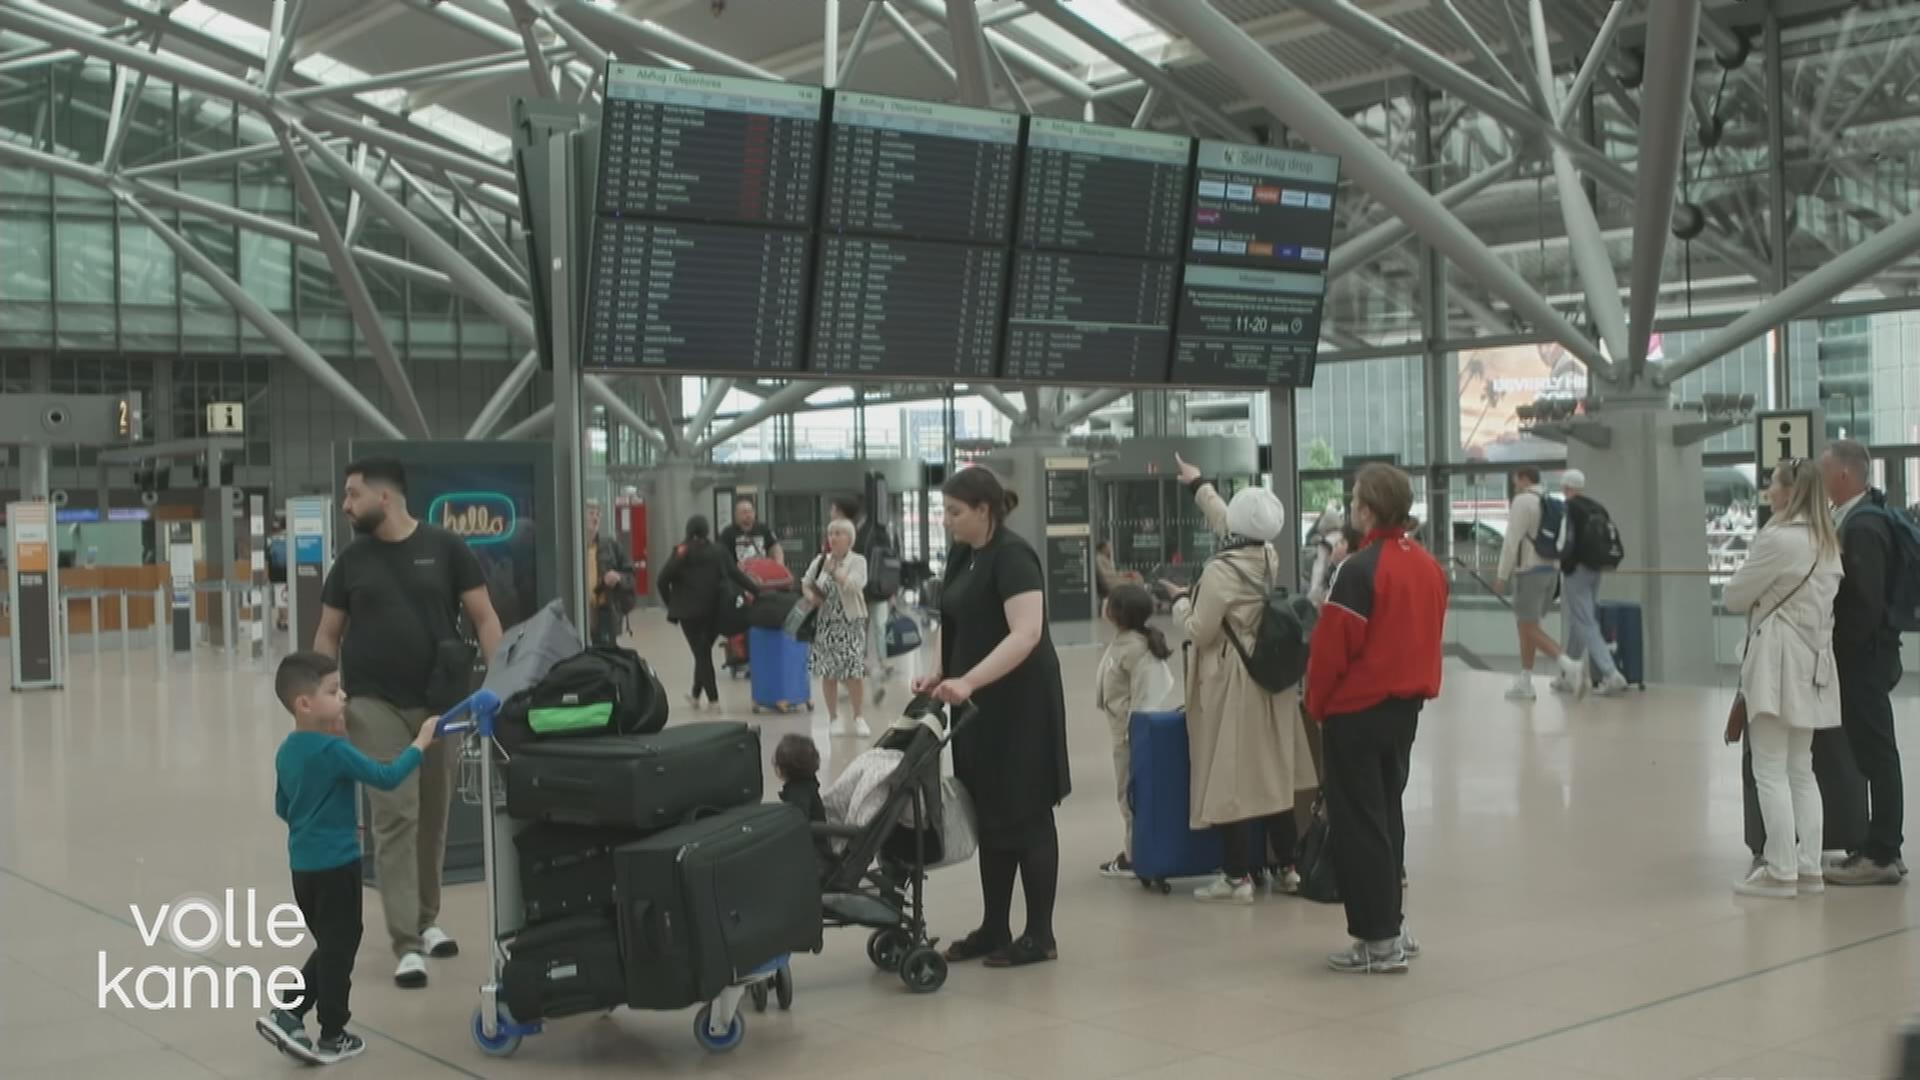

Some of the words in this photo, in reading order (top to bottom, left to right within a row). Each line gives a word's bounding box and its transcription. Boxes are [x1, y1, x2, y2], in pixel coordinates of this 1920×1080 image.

[1241, 150, 1263, 165] Self
[1265, 153, 1286, 172] bag
[1288, 155, 1313, 175] drop
[443, 501, 503, 535] hello
